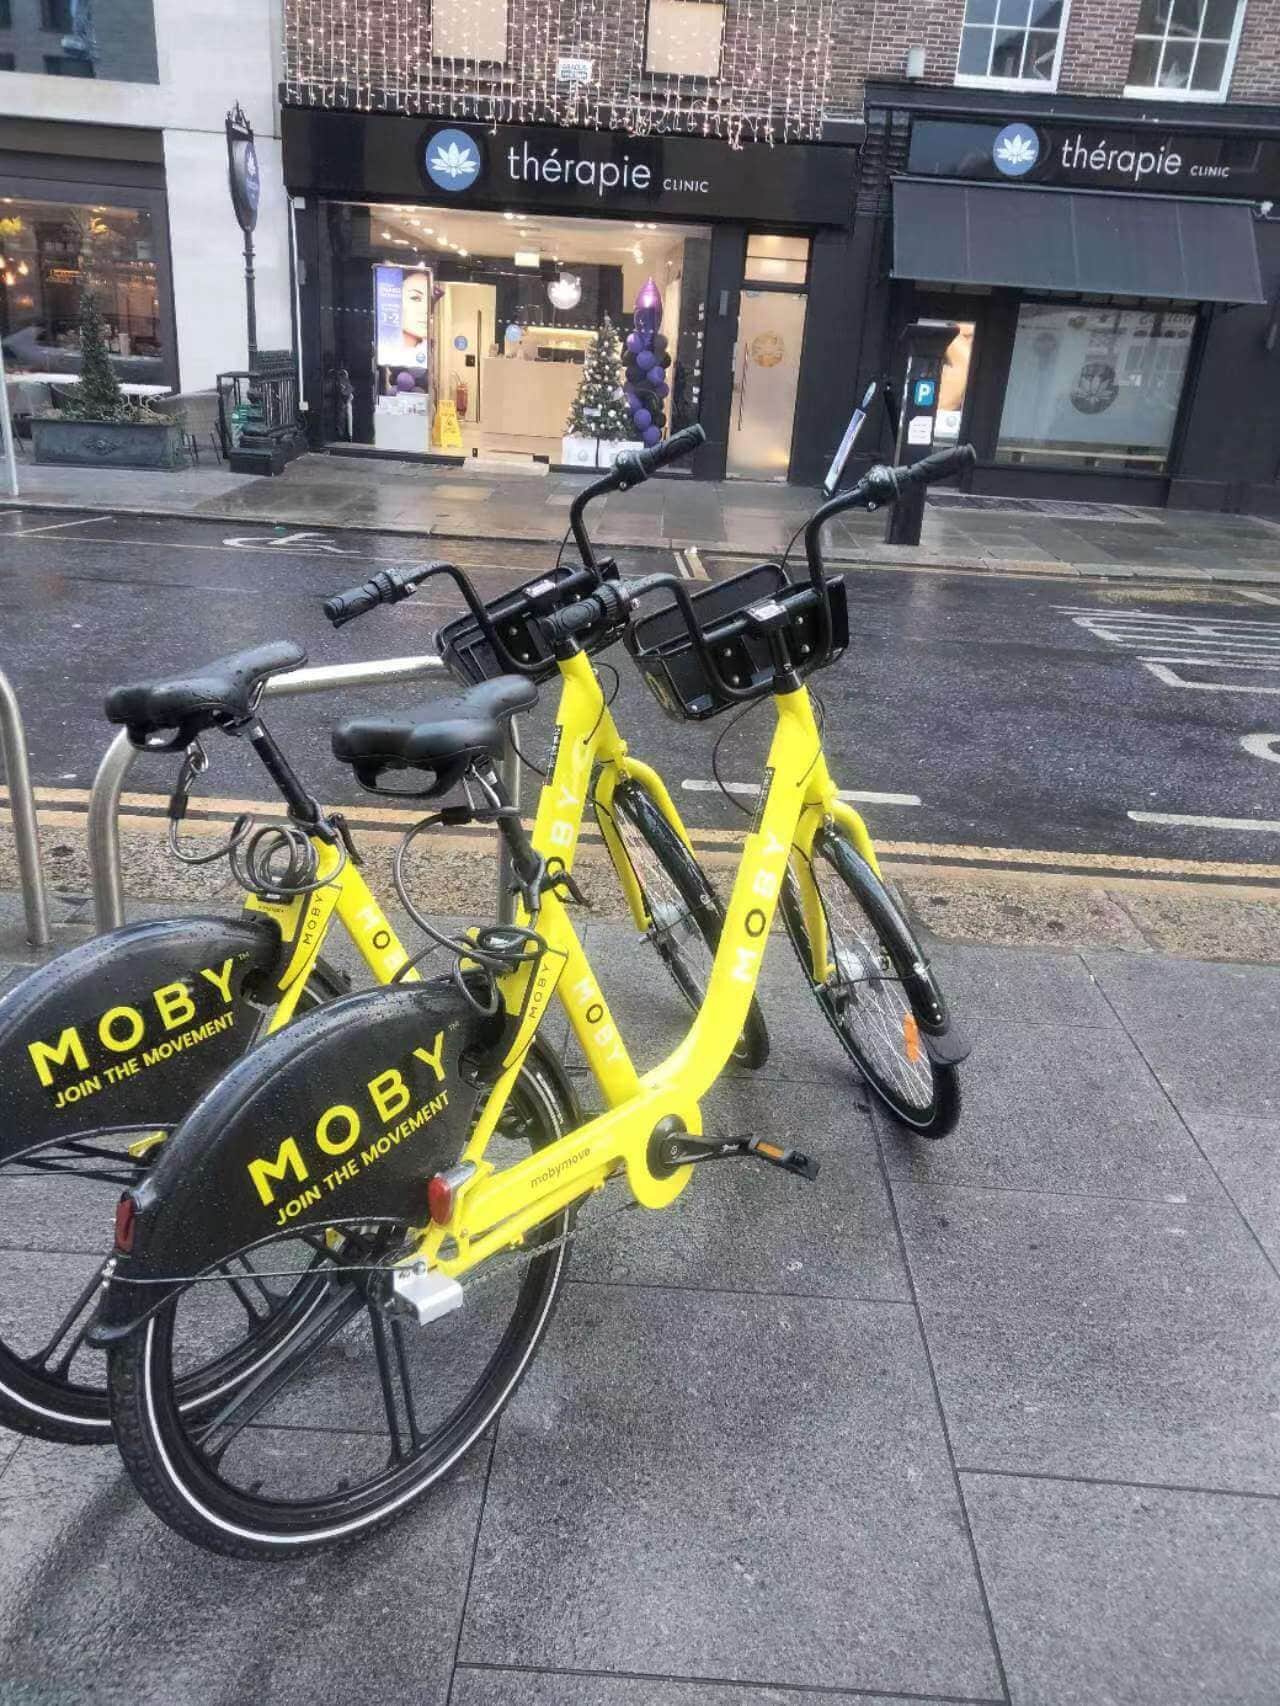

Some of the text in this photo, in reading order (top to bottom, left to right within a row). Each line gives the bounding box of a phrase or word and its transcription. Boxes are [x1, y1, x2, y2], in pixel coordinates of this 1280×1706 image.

[507, 140, 710, 197] thérapie CLINIC
[1062, 133, 1231, 183] thérapie CLINIC
[917, 383, 932, 403] P
[302, 893, 323, 945] MOBY
[731, 830, 785, 983] MOBY
[28, 958, 234, 1087] MOBY
[528, 962, 551, 1019] MOBY
[571, 975, 625, 1064] MOBY
[55, 1012, 235, 1109] JOIN THE MOVEMENT
[248, 1030, 446, 1206] MOBY
[275, 1090, 449, 1226] JOIN THE MOVEMENT
